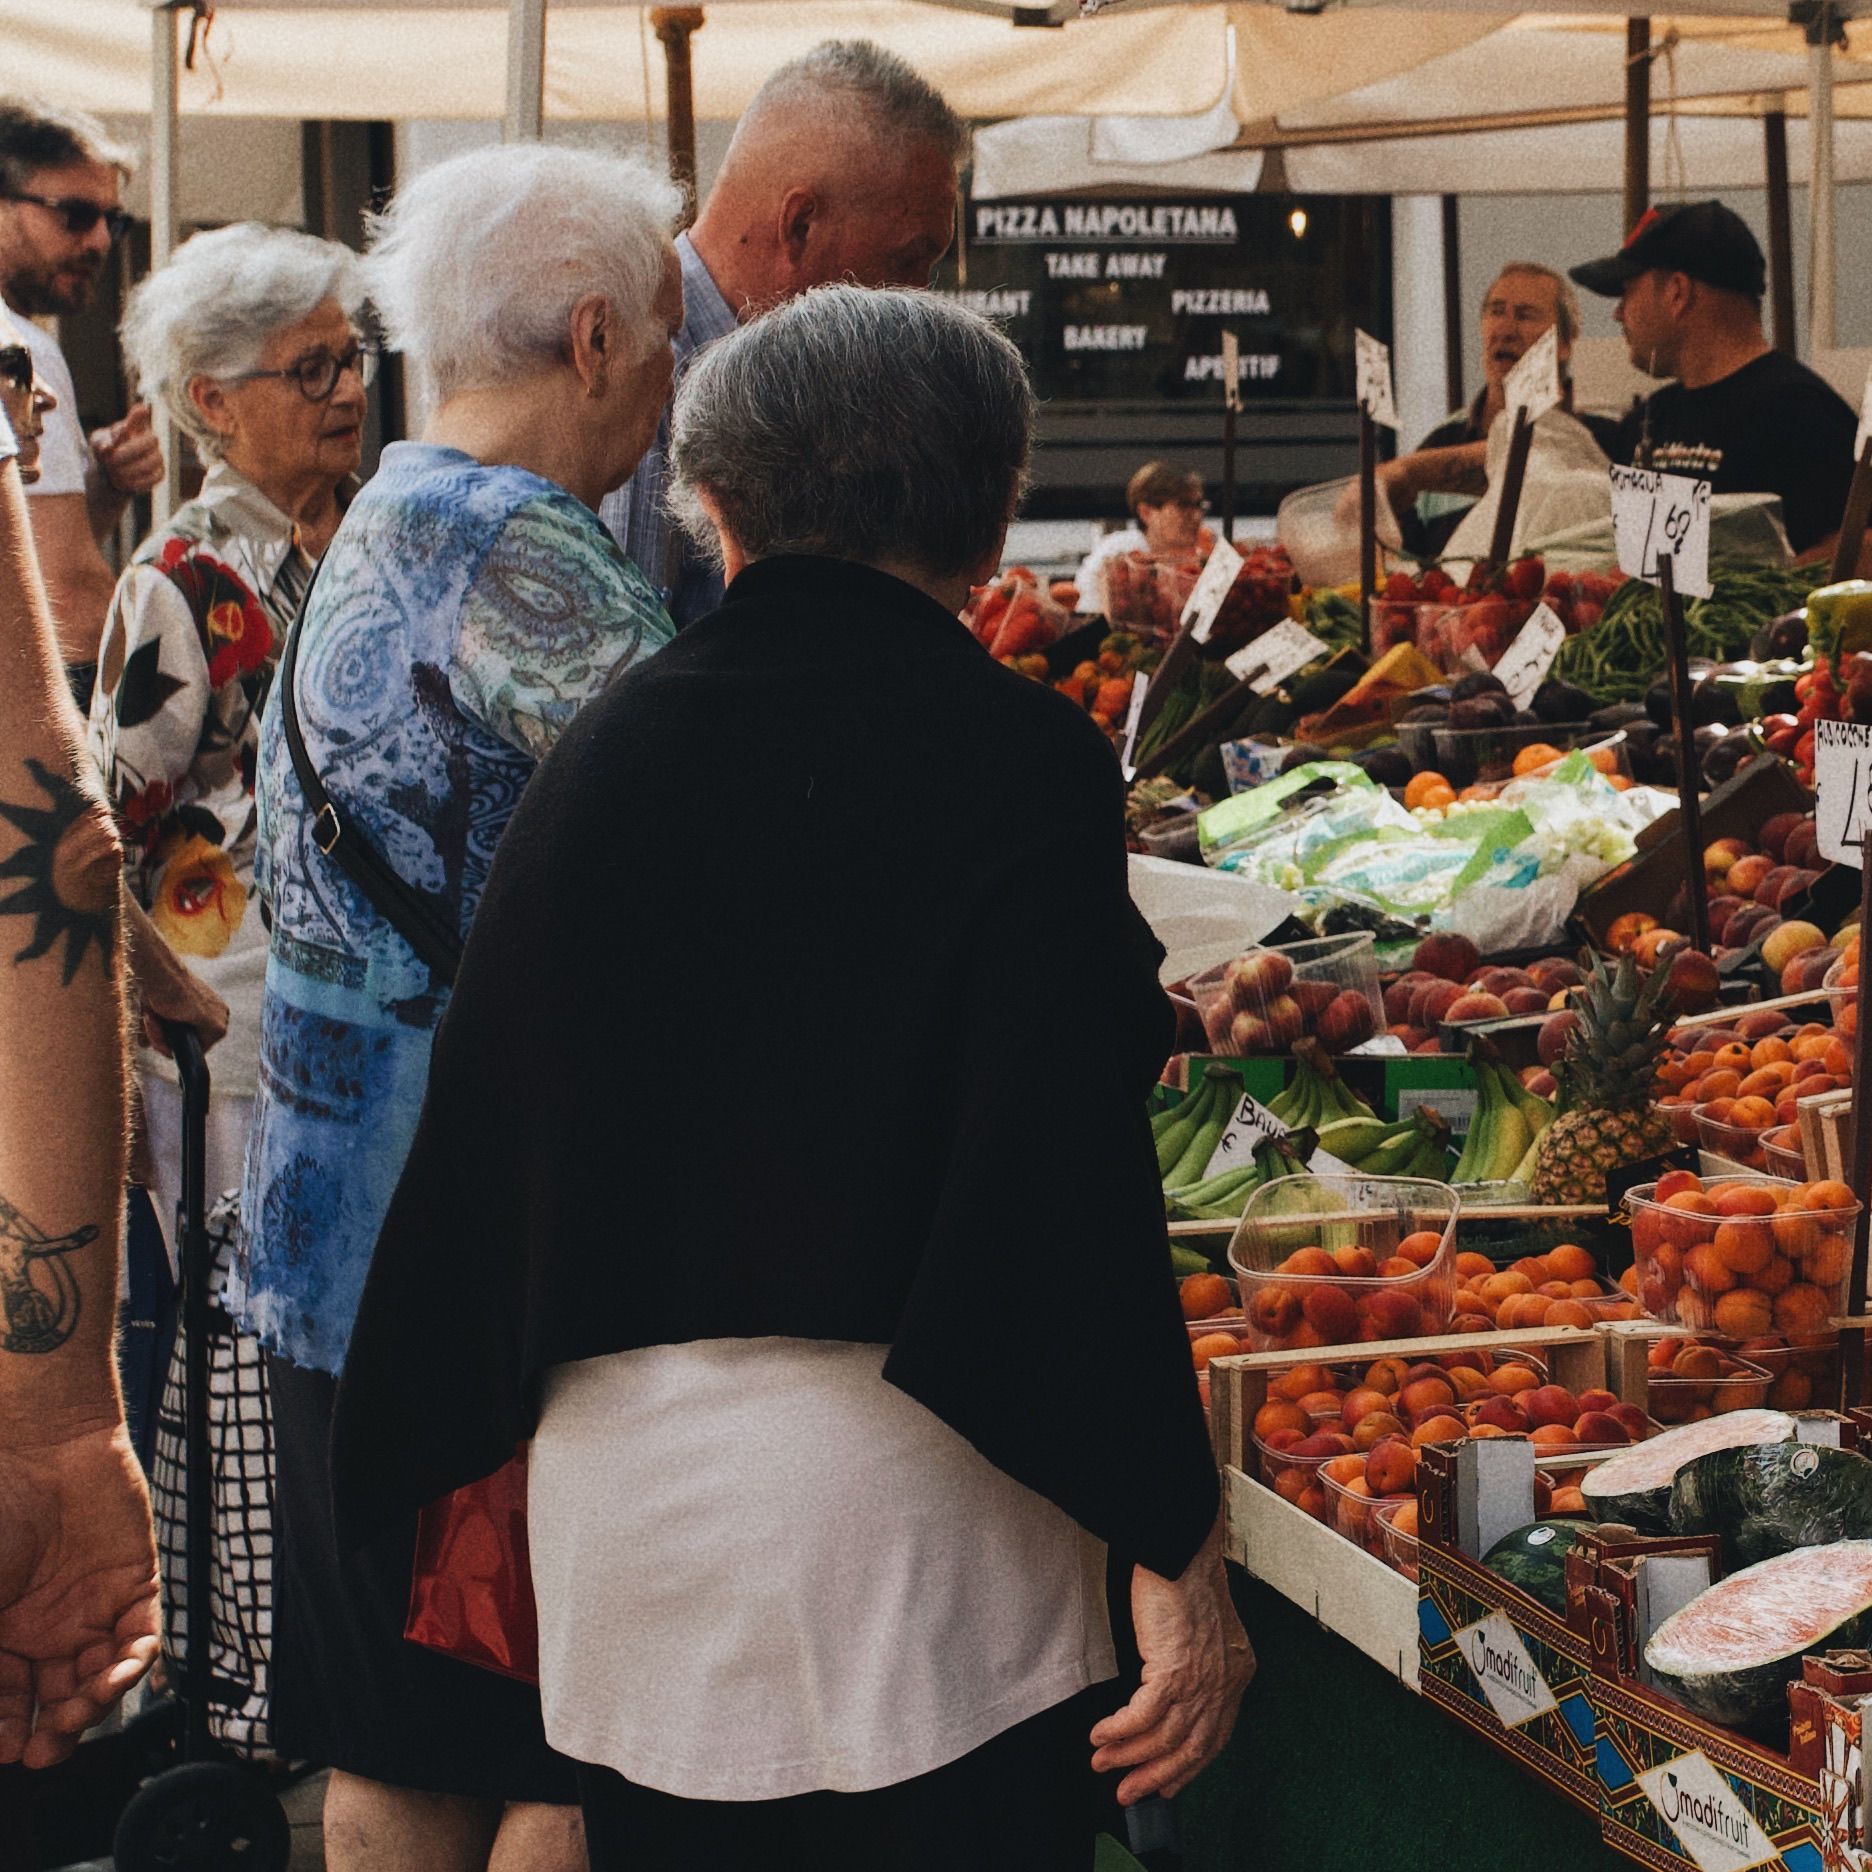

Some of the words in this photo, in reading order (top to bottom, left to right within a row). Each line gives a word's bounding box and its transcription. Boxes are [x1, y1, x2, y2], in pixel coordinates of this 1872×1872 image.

[976, 207, 1058, 236] PIZZA
[1064, 207, 1238, 237] NAPOLETANA
[1045, 253, 1099, 278] TAKE
[1105, 253, 1167, 278] AWAY
[1171, 289, 1270, 315] PIZZERIA
[1063, 326, 1148, 350] BAKERY
